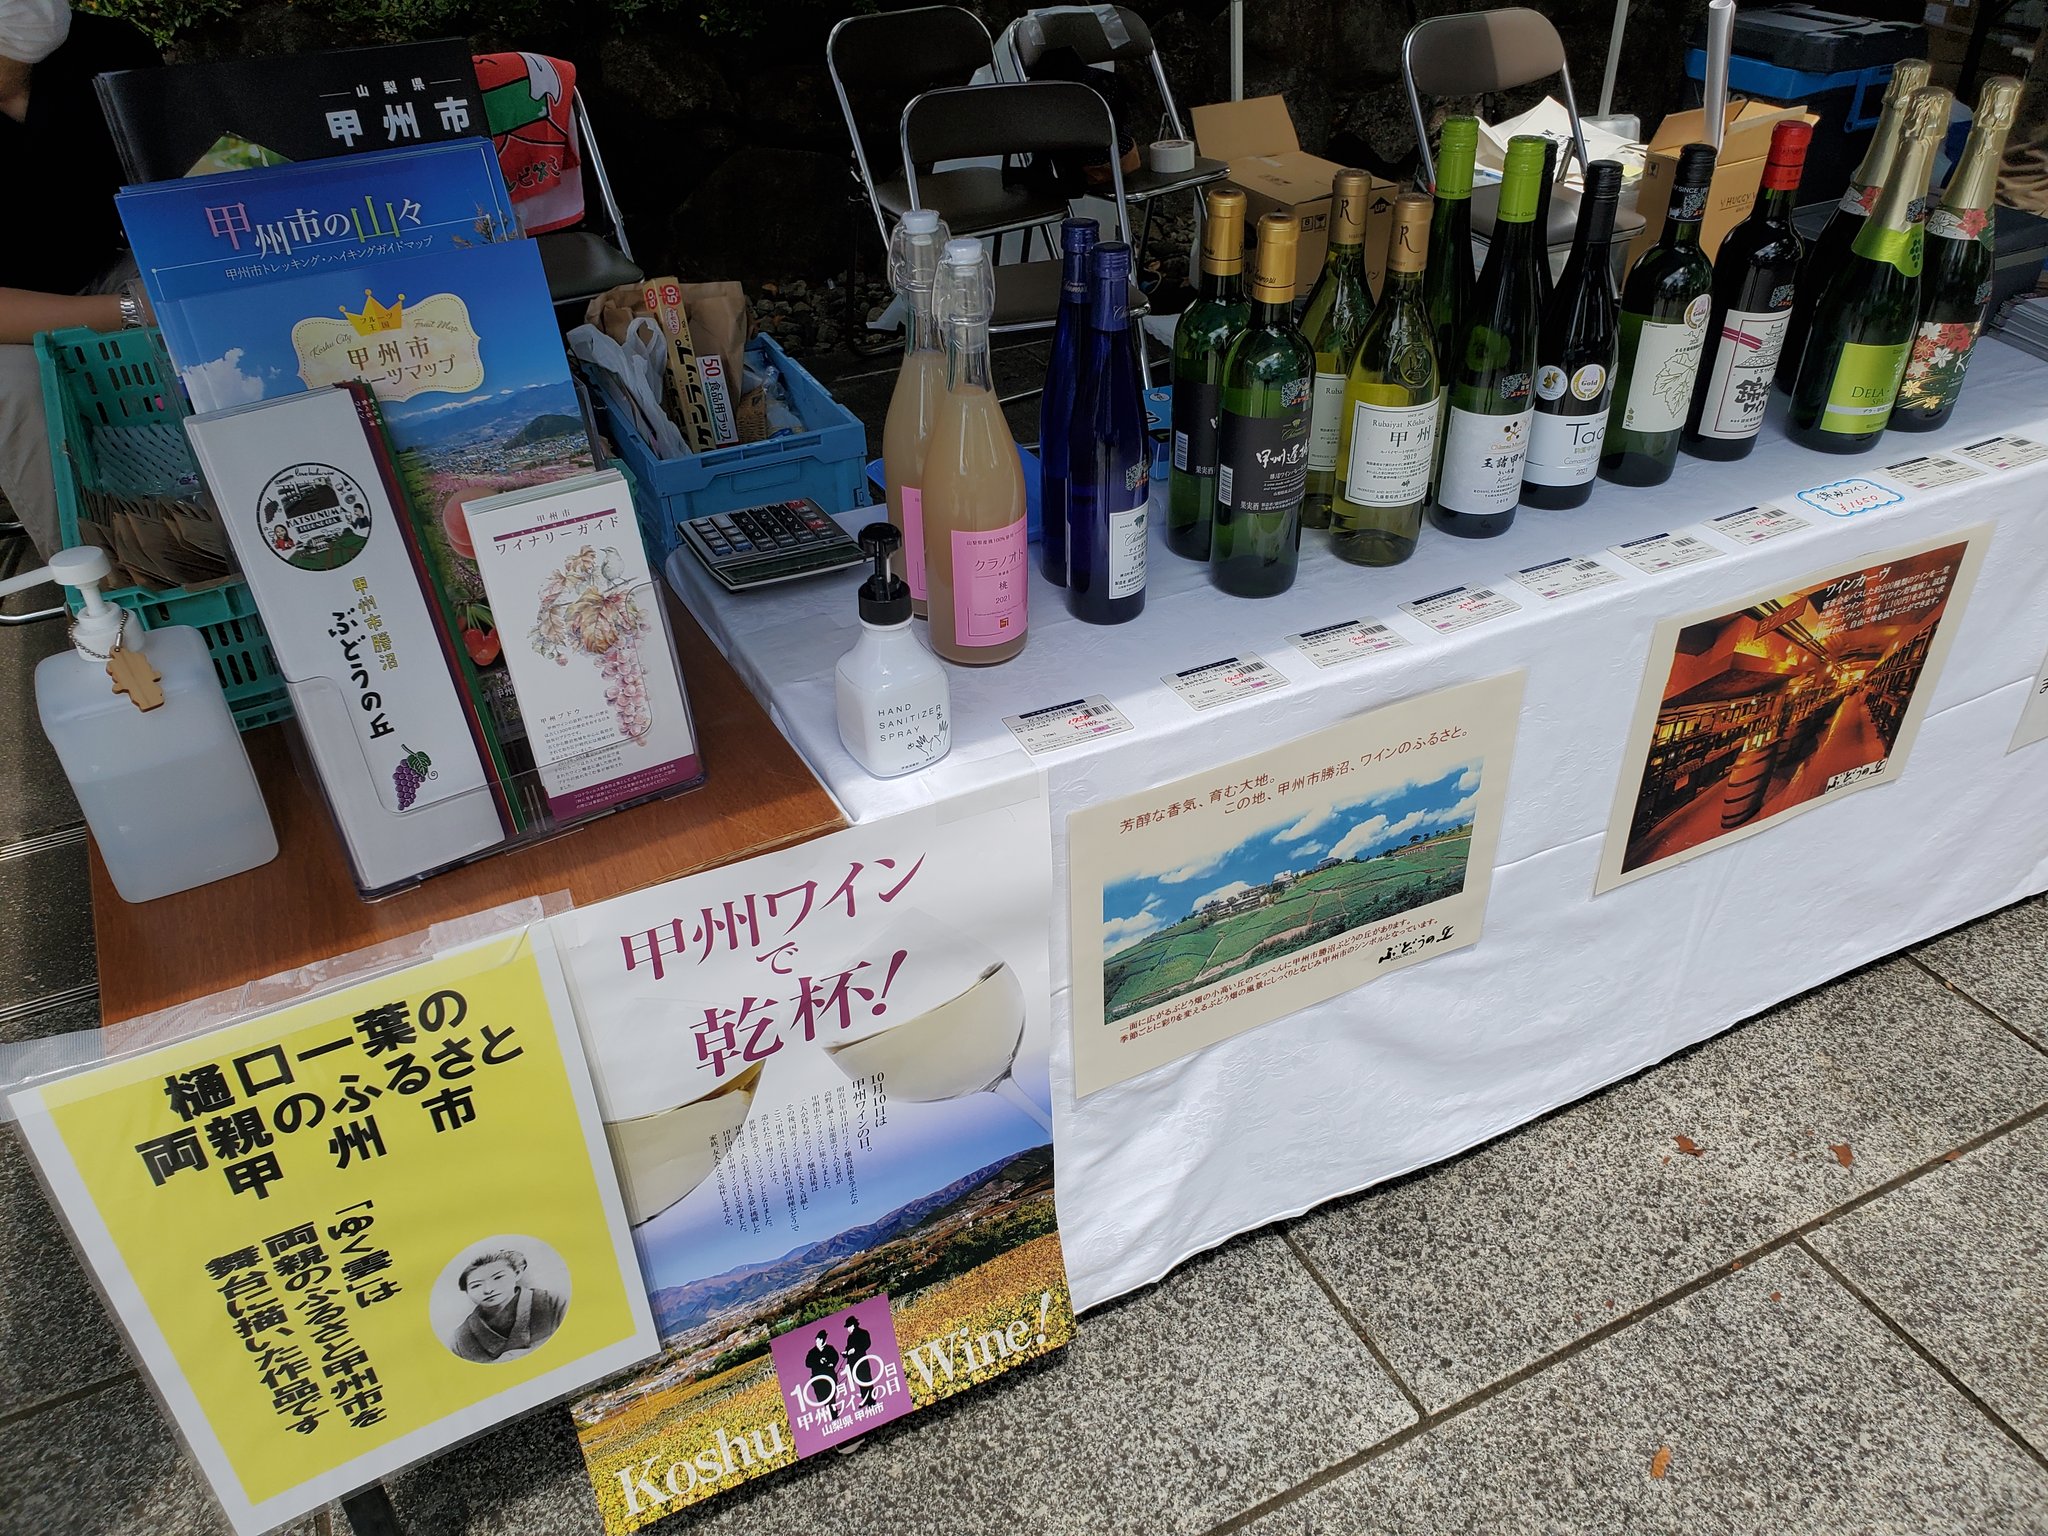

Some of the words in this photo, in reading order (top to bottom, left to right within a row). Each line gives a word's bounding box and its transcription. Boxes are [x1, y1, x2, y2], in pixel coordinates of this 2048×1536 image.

[356, 77, 426, 98] 山梨県
[324, 96, 471, 147] 甲州市
[1374, 203, 1387, 212] UP
[203, 194, 423, 262] 甲州市の山々
[224, 235, 434, 284] 甲州市トレッキング・ハイキングガイドマップ
[360, 312, 393, 324] フルーツ
[369, 321, 390, 332] 王国
[347, 335, 430, 371] 甲州市
[702, 358, 721, 377] 50
[1581, 379, 1598, 387] Gold
[710, 381, 732, 442] 食品用ラップ
[1372, 419, 1403, 430] Rubaiyat
[1390, 426, 1432, 448] 甲州
[1195, 465, 1214, 475] 果実酒
[1403, 452, 1417, 461] 2019
[1481, 449, 1526, 470] 玉諸甲州
[285, 505, 347, 529] KATSUNUMA
[536, 508, 571, 524] 甲州市
[1240, 501, 1260, 511] 果実酒
[495, 516, 620, 556] ワイナリーガイド
[974, 549, 1024, 572] クラノオト
[995, 594, 1011, 604] 2021
[998, 580, 1009, 591] 桃
[1825, 566, 1892, 597] ワインカーヴ
[352, 576, 398, 671] 甲州市勝沼
[328, 607, 395, 740] ぶどうの丘
[878, 703, 912, 717] HAND
[878, 704, 942, 730] SANITIZER
[880, 725, 921, 742] SPRAY
[1223, 725, 1469, 816] この地、甲州市勝沼、ワインのふるさと。
[1826, 759, 1886, 792] ぶどうの丘
[1119, 773, 1278, 835] 芳醇な香気、育む大地。
[620, 851, 927, 981] 甲州ワイン
[755, 941, 800, 975] で
[1378, 925, 1455, 964] ぶどうの丘
[1119, 918, 1411, 1033] 一面に広がるぶどう畑の小高い丘のてっぺんに甲州市勝沼ぶどうの丘があります。
[689, 949, 909, 1078] 乾杯!
[163, 989, 470, 1125] 樋口一葉の
[133, 1023, 526, 1188] 両親のふるさと
[852, 1077, 874, 1154] 甲州ワインの日。
[869, 1071, 889, 1129] 10月10日は
[222, 1084, 479, 1202] 甲州市
[325, 1197, 405, 1311] 「ゆく雲」は
[204, 1243, 325, 1437] 舞台に描いた作品です
[260, 1220, 389, 1431] 両親のふるさと甲州市を
[904, 1290, 1051, 1394] Wine!
[790, 1353, 897, 1411] 10月10日
[795, 1377, 902, 1432] 甲州ワインの日
[820, 1413, 854, 1438] 山梨県
[854, 1401, 886, 1426] 甲州市
[612, 1417, 790, 1519] Koshu
